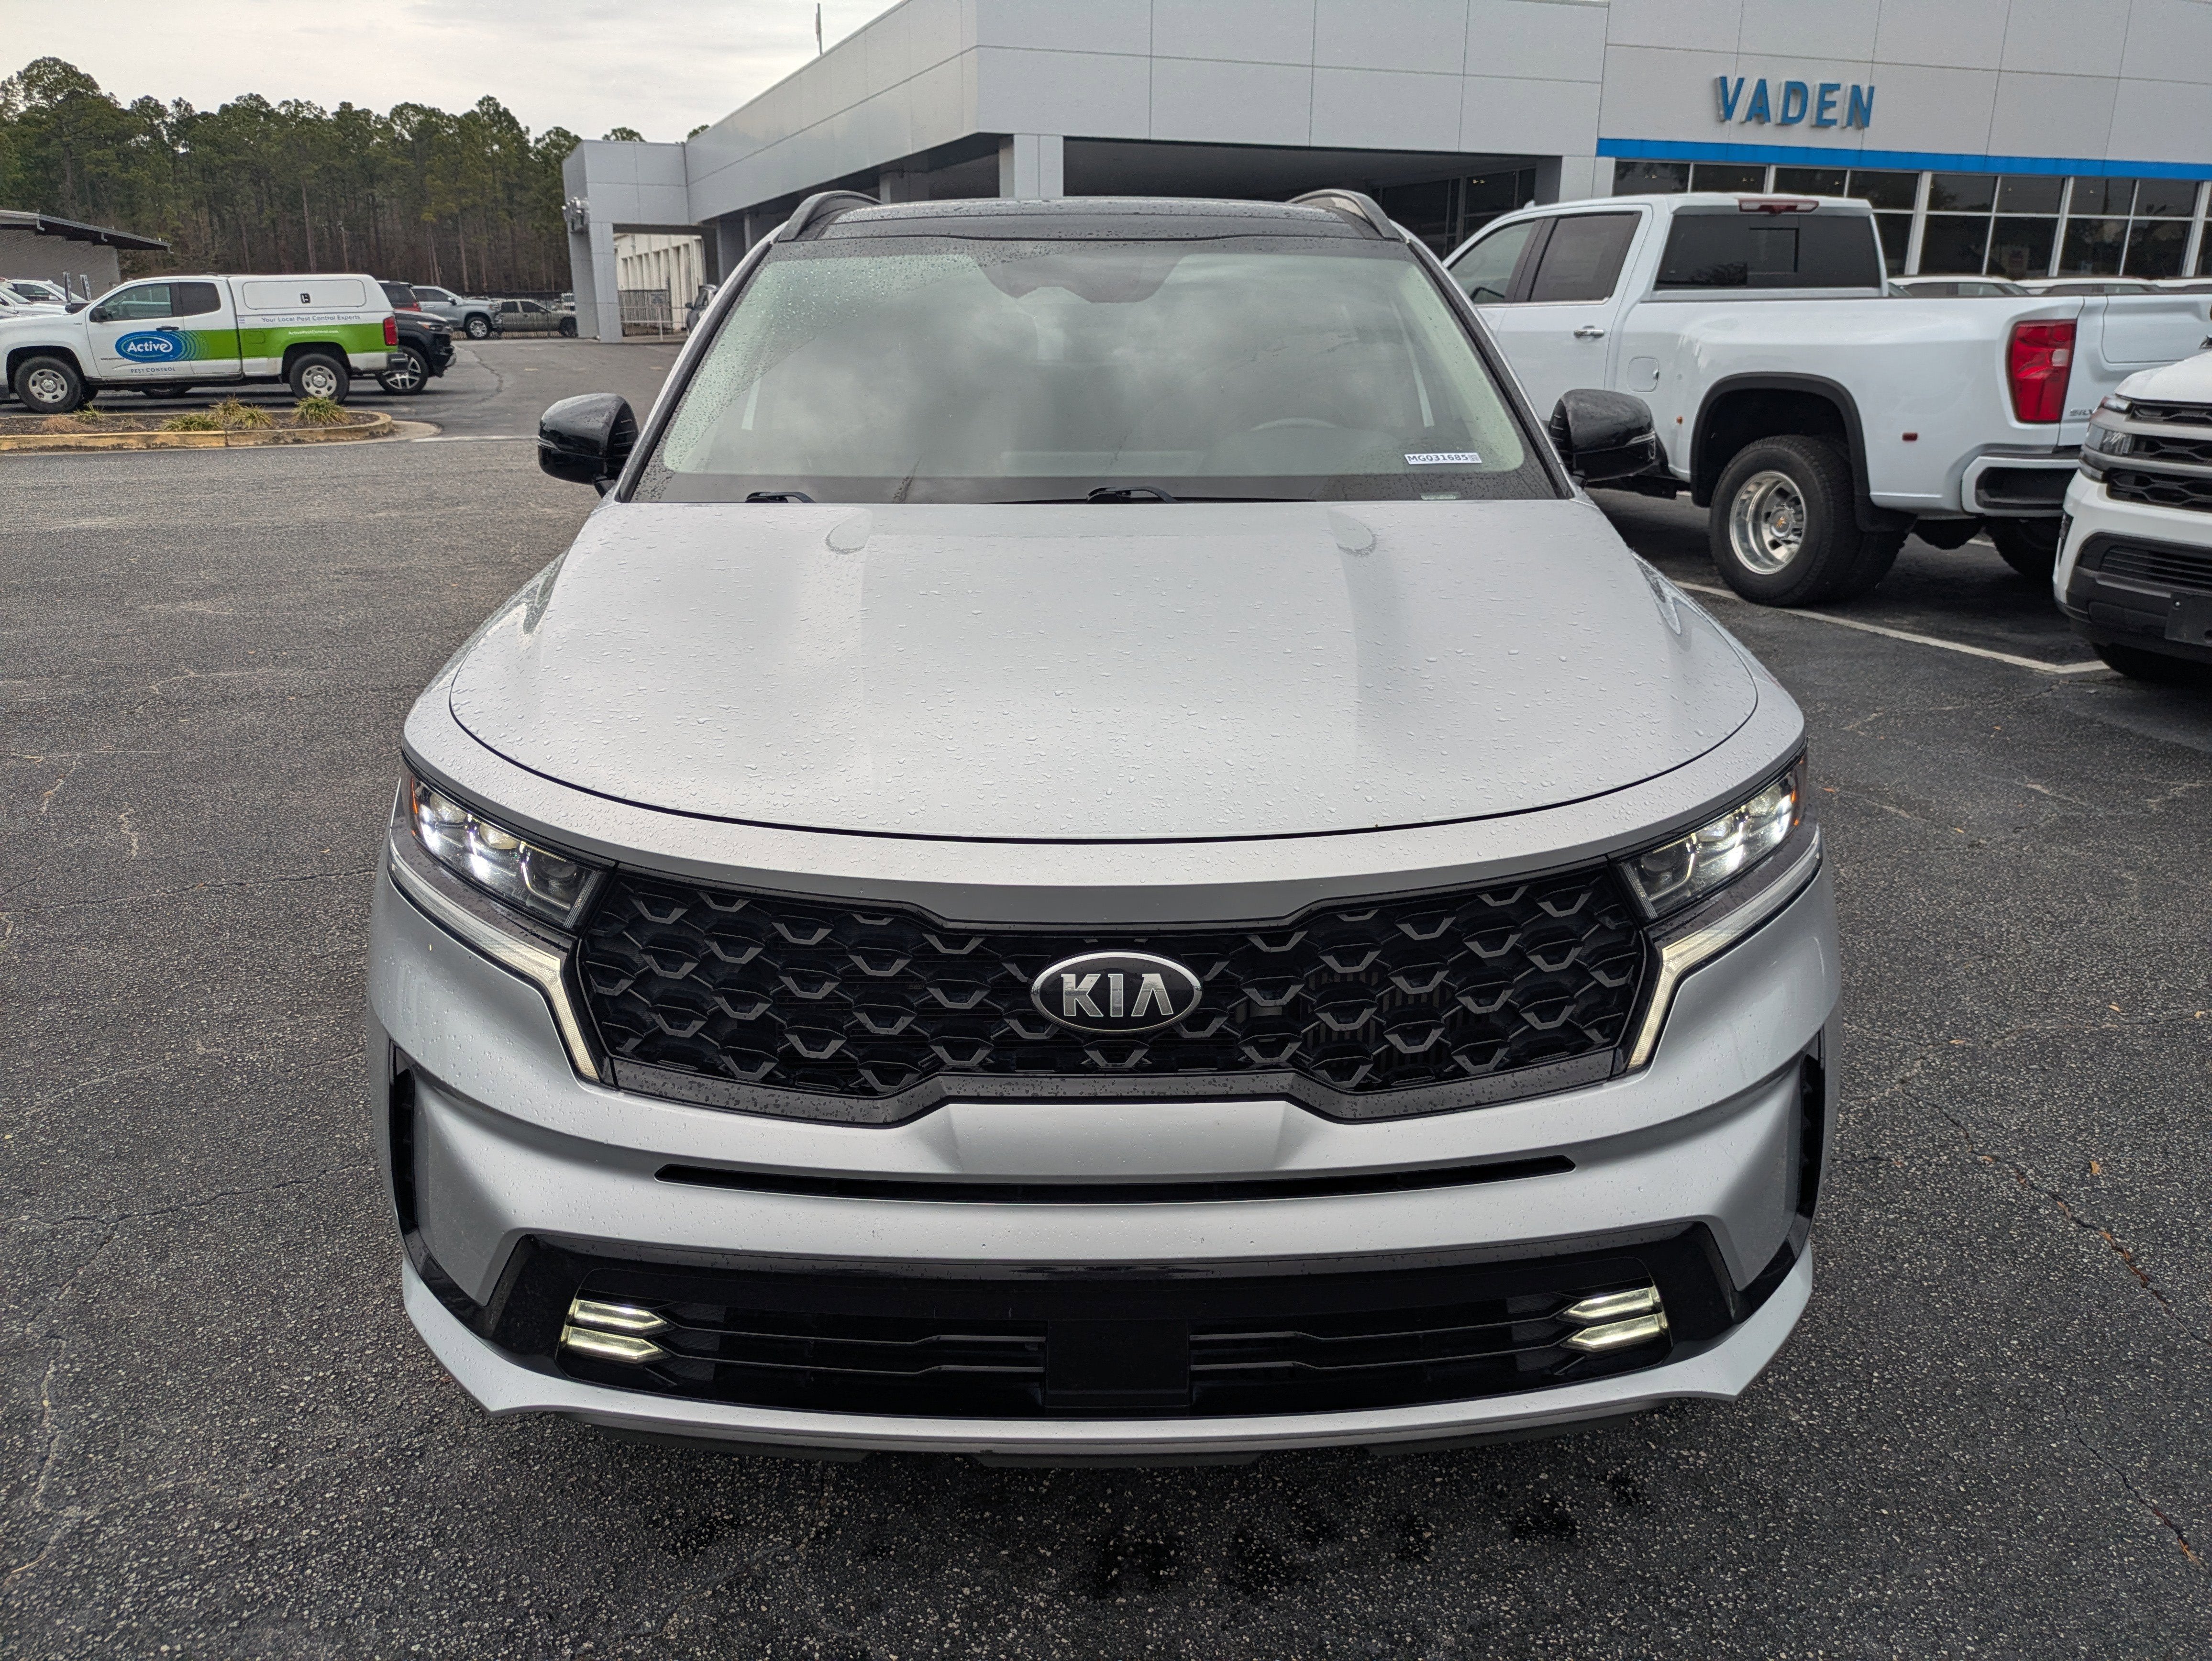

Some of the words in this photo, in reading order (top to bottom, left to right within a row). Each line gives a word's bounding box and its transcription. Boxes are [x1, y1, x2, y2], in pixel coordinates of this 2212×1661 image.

[1718, 76, 1875, 128] VADEN
[127, 341, 173, 353] Active
[1061, 973, 1174, 1017] KIA
